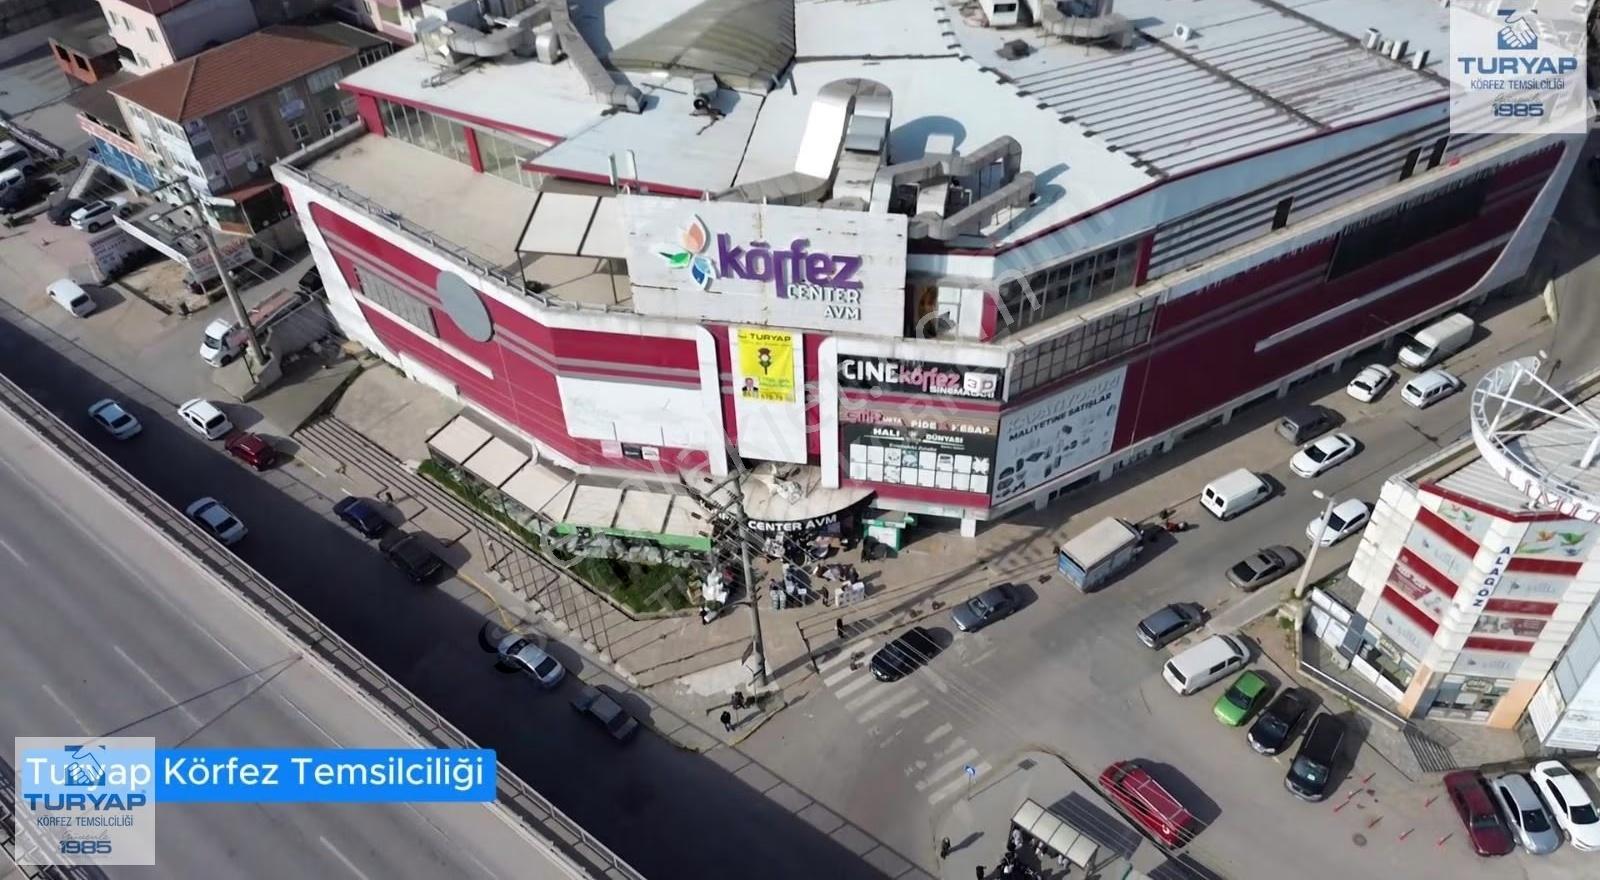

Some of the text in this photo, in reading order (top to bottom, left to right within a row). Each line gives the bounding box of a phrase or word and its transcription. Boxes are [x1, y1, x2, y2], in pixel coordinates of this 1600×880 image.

[787, 284, 861, 305] CENTER
[824, 304, 861, 321] AVM
[750, 333, 791, 342] TURYAP
[873, 428, 963, 444] HALI DÜNYASI
[748, 514, 837, 532] CENTER AVM
